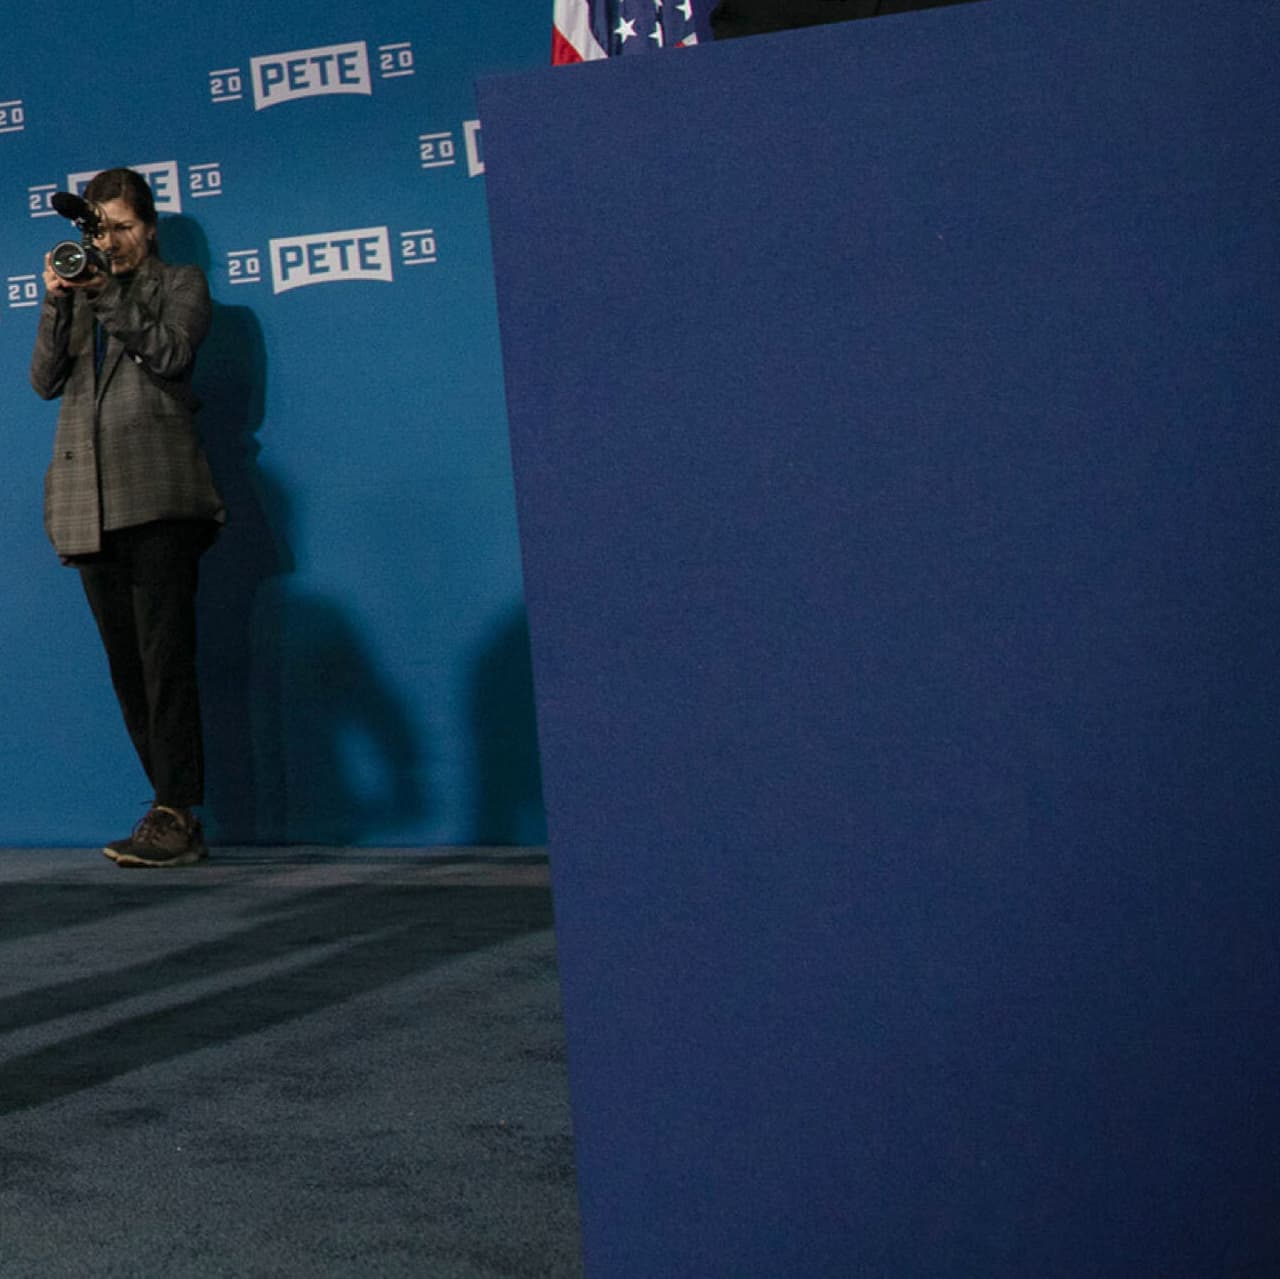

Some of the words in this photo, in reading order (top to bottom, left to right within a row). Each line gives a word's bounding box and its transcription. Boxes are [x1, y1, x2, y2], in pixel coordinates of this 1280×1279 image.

[210, 75, 241, 95] 20
[259, 51, 361, 98] PETE
[379, 49, 414, 70] 20
[419, 139, 454, 160] 20
[189, 170, 221, 190] 20
[228, 257, 260, 276] 20
[278, 235, 382, 281] PETE
[401, 237, 436, 257] 20
[8, 282, 38, 301] 20
